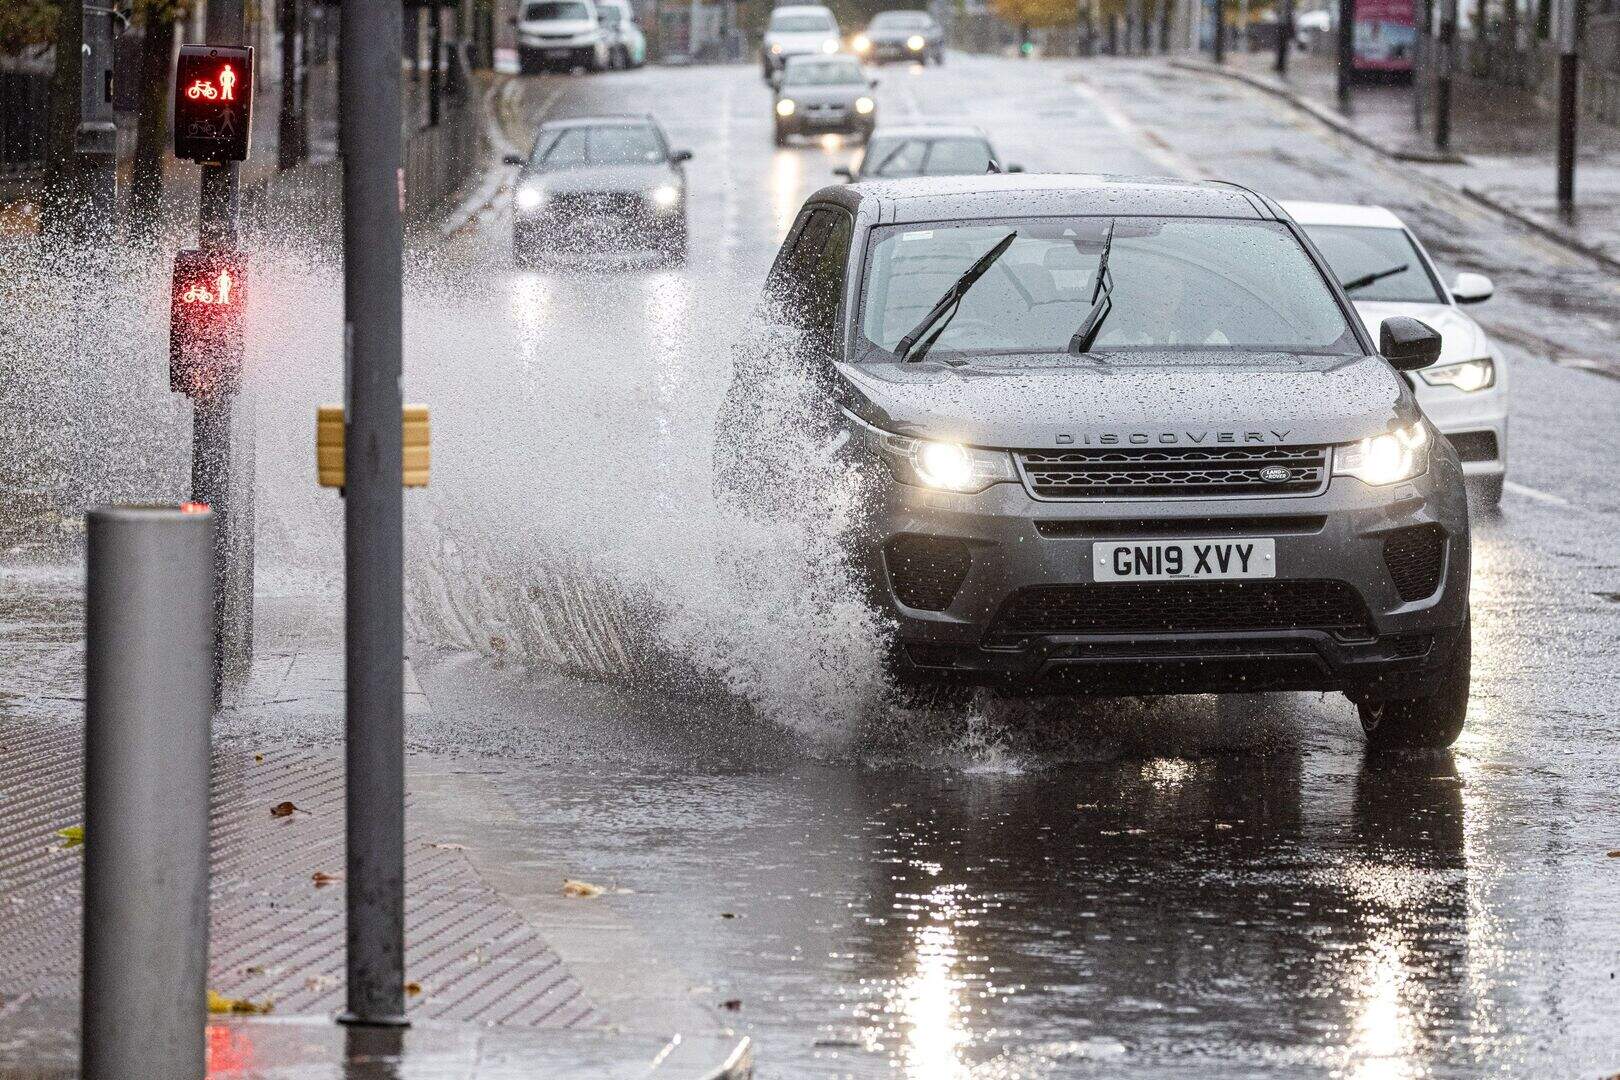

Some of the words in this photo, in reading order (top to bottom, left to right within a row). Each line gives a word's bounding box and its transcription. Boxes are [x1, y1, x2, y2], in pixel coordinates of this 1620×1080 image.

[1055, 430, 1291, 445] DISCOVERY
[1113, 546, 1183, 576] GN19
[1193, 544, 1254, 574] XVY
